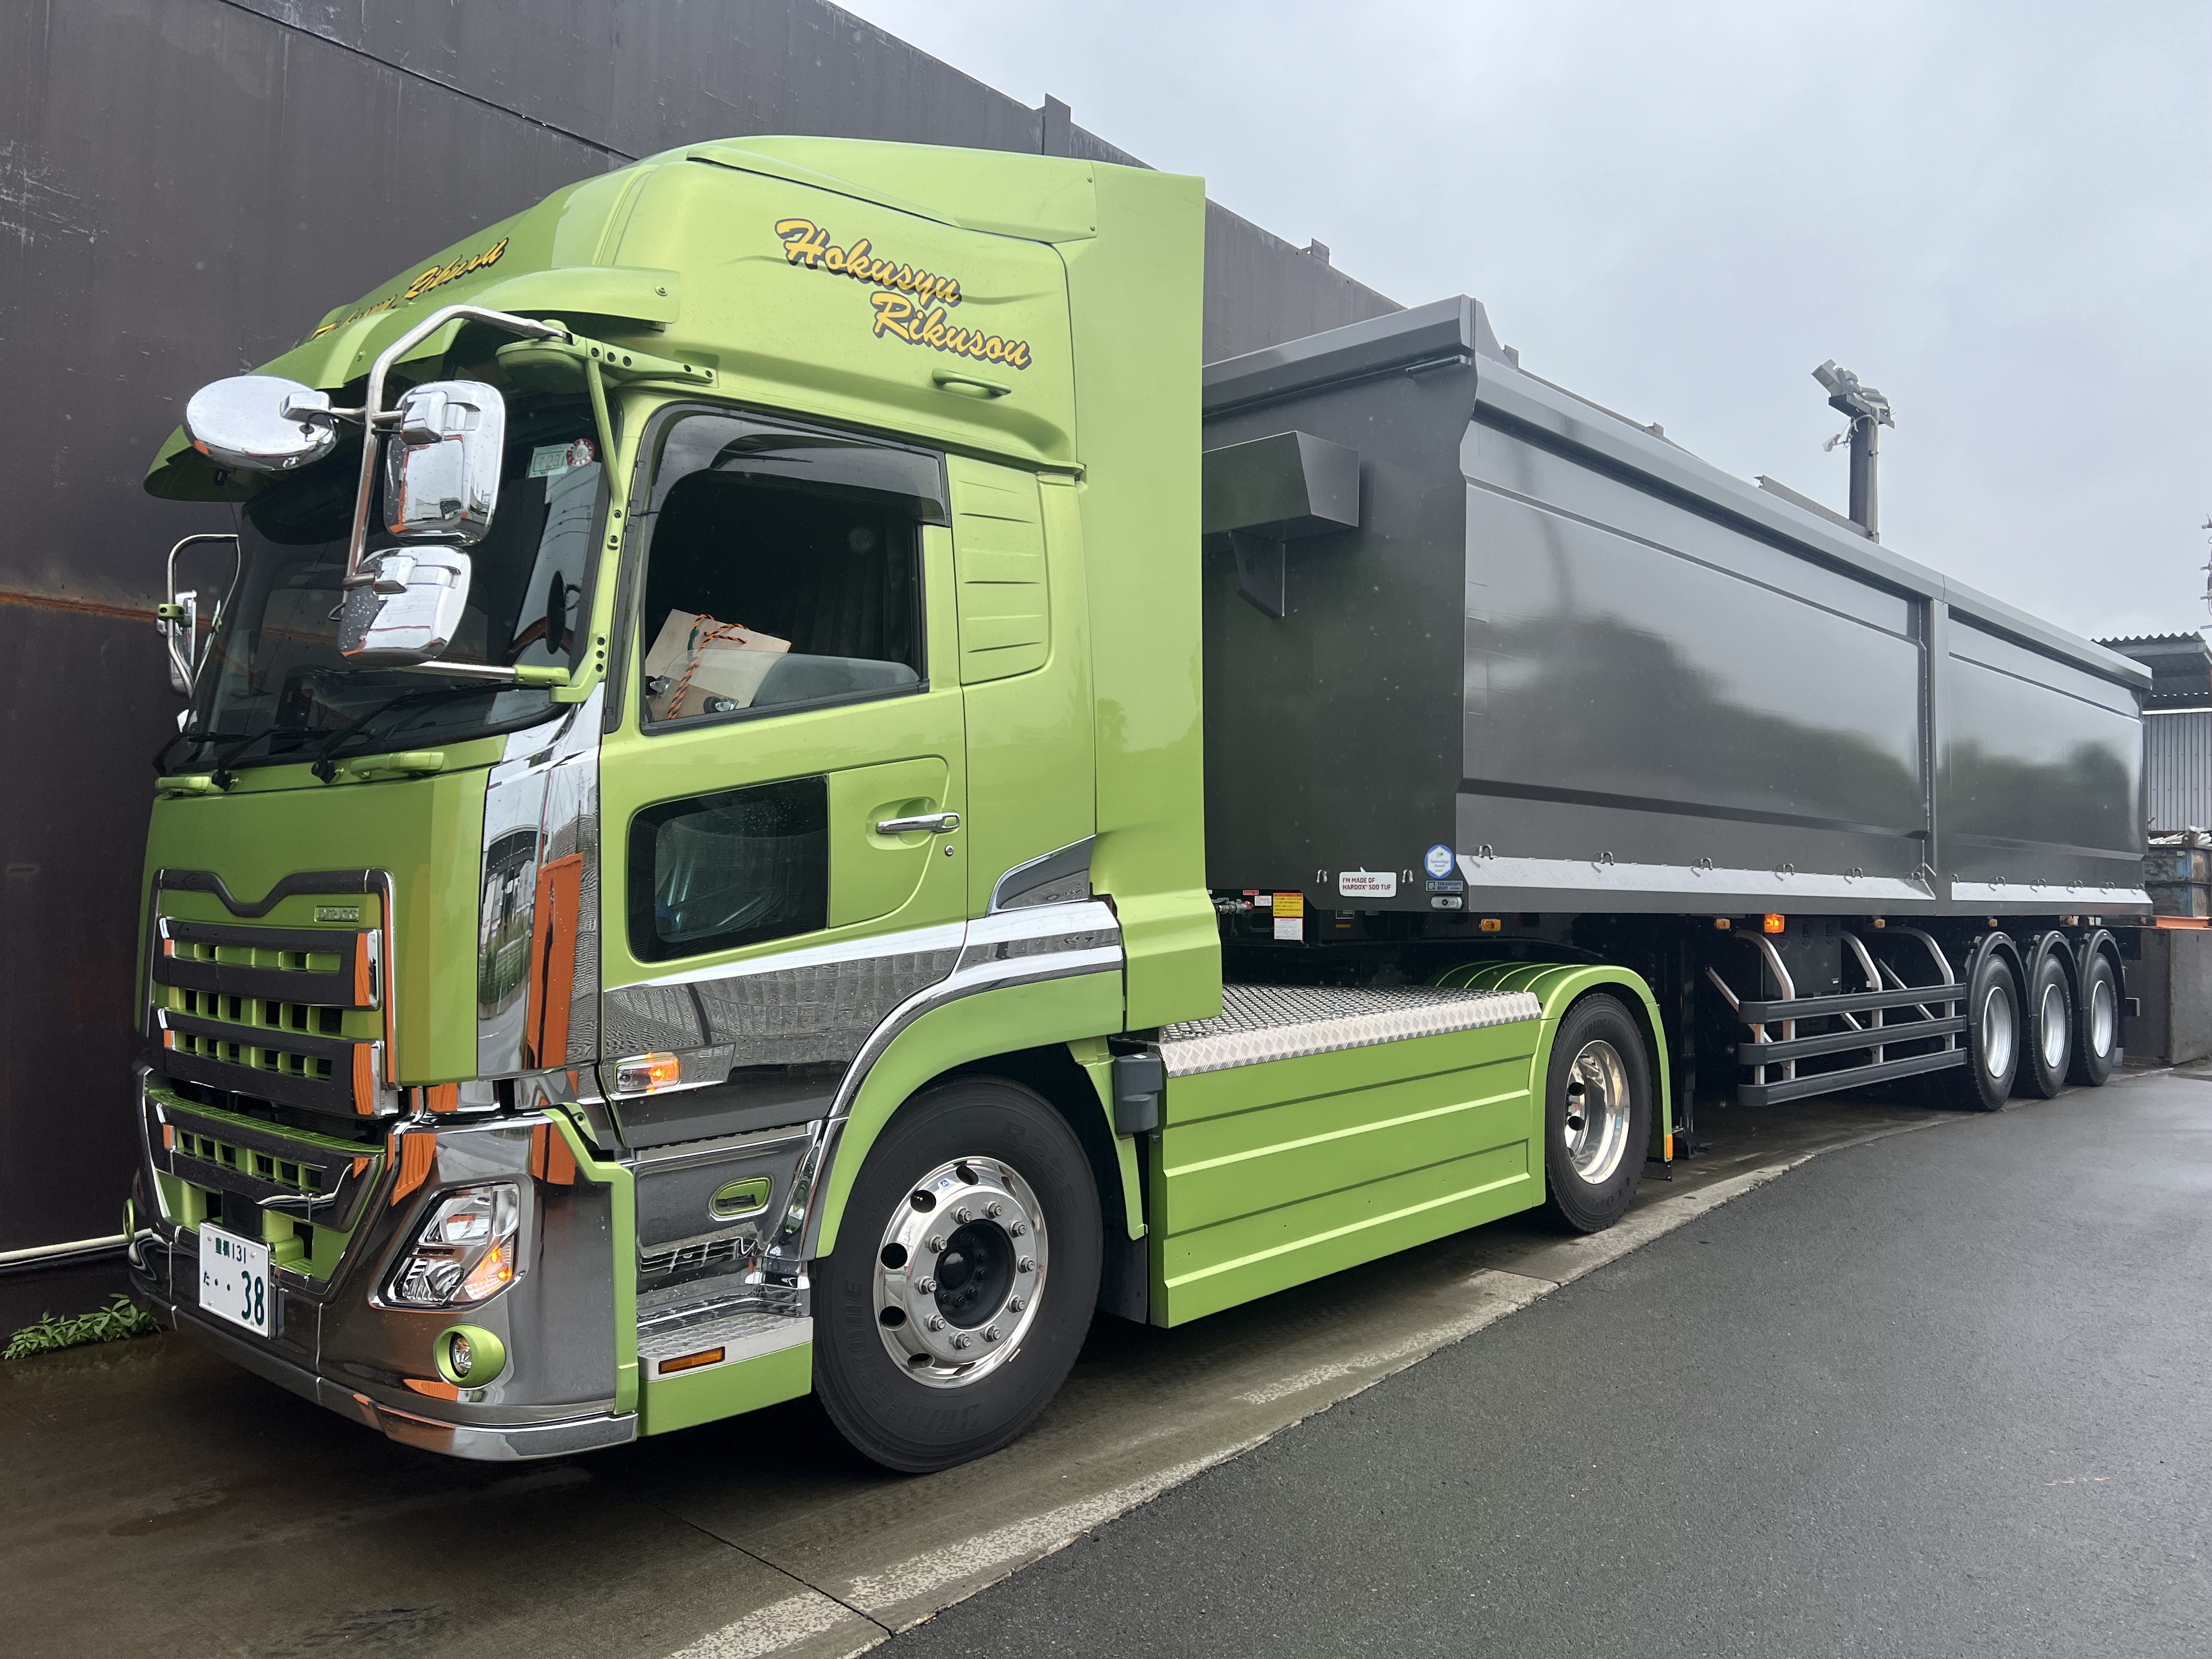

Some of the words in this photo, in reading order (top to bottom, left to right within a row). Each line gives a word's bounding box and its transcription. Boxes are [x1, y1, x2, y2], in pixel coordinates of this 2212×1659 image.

[775, 219, 962, 311] Hokusyu
[870, 291, 1032, 370] Rikusou
[233, 1243, 246, 1263] 131
[241, 1271, 264, 1326] 38
